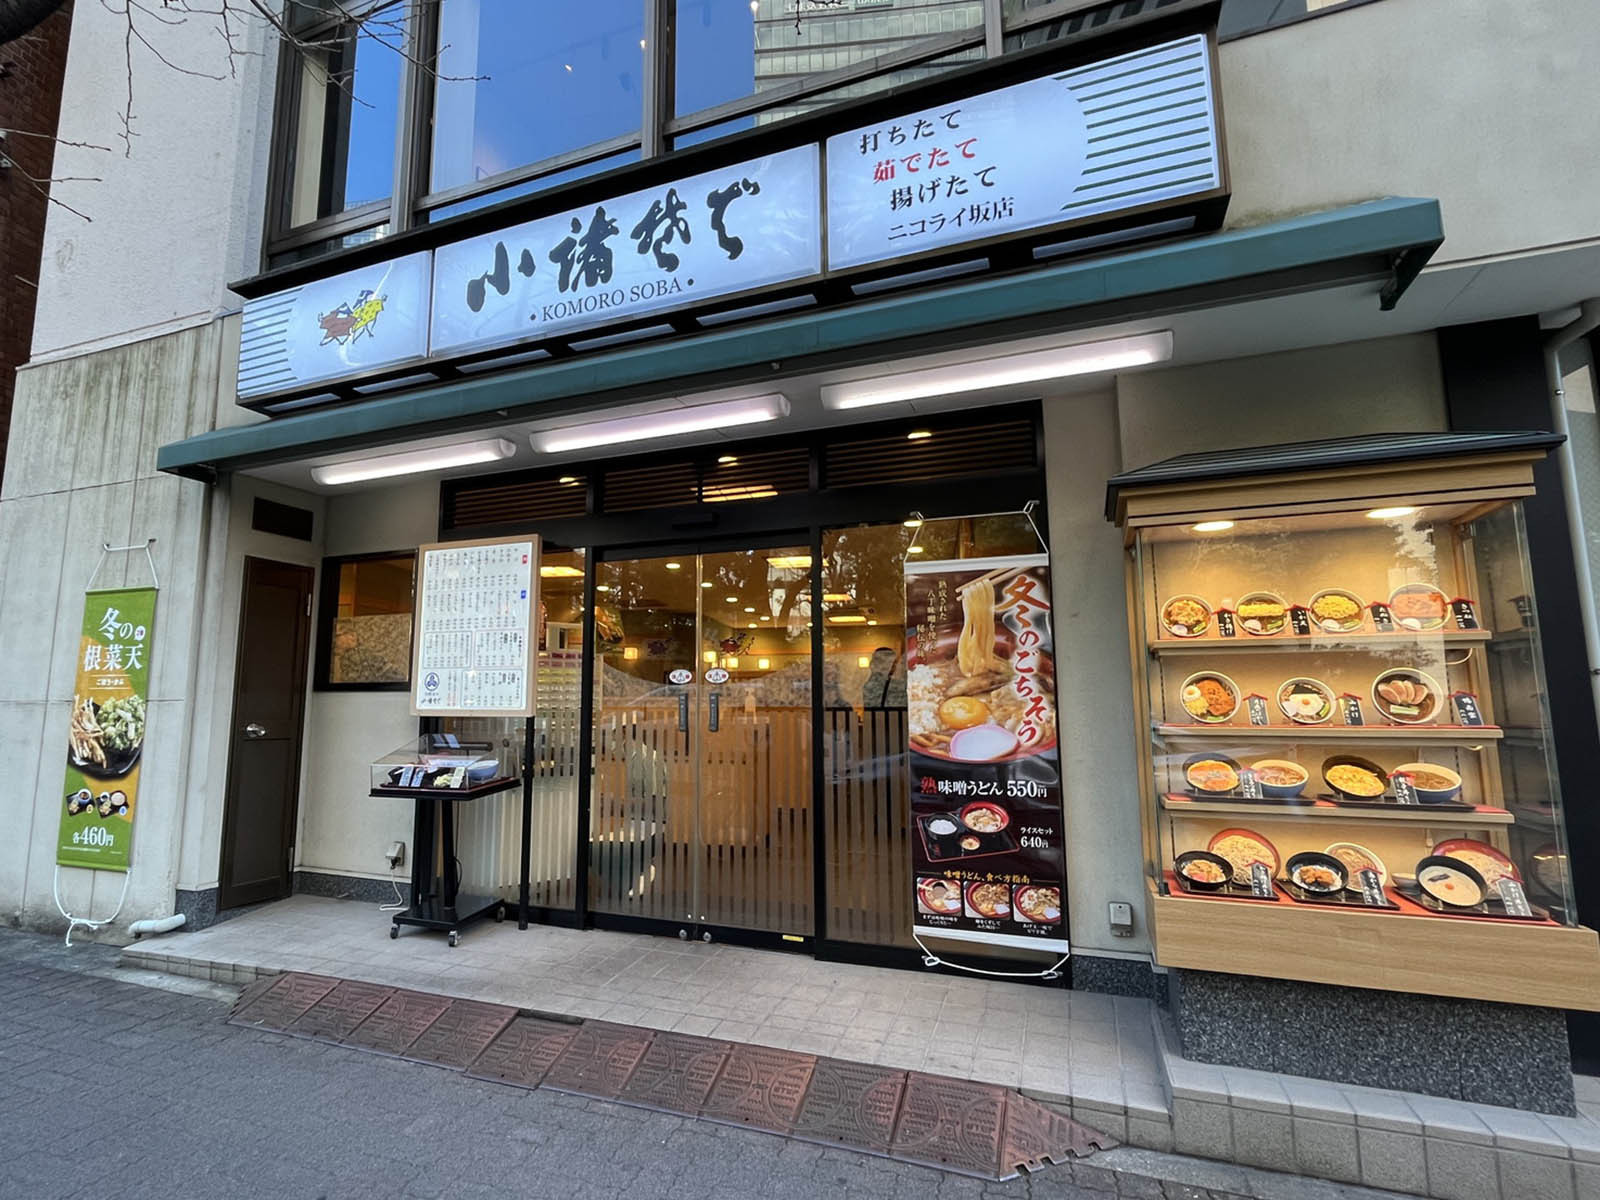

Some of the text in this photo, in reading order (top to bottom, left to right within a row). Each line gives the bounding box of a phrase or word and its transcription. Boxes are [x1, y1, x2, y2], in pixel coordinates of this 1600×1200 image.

[860, 109, 961, 154] 打ちたて
[873, 138, 977, 184] 茹でたて
[890, 166, 997, 211] 揚げたて
[888, 197, 1014, 240] ニコライ坂店
[542, 276, 682, 322] KOMORO SOBA
[98, 607, 133, 640] 冬の
[84, 643, 144, 671] 根菜天
[1006, 780, 1048, 798] 550円
[1020, 826, 1053, 835] ライスセット
[1020, 836, 1049, 849] 640円
